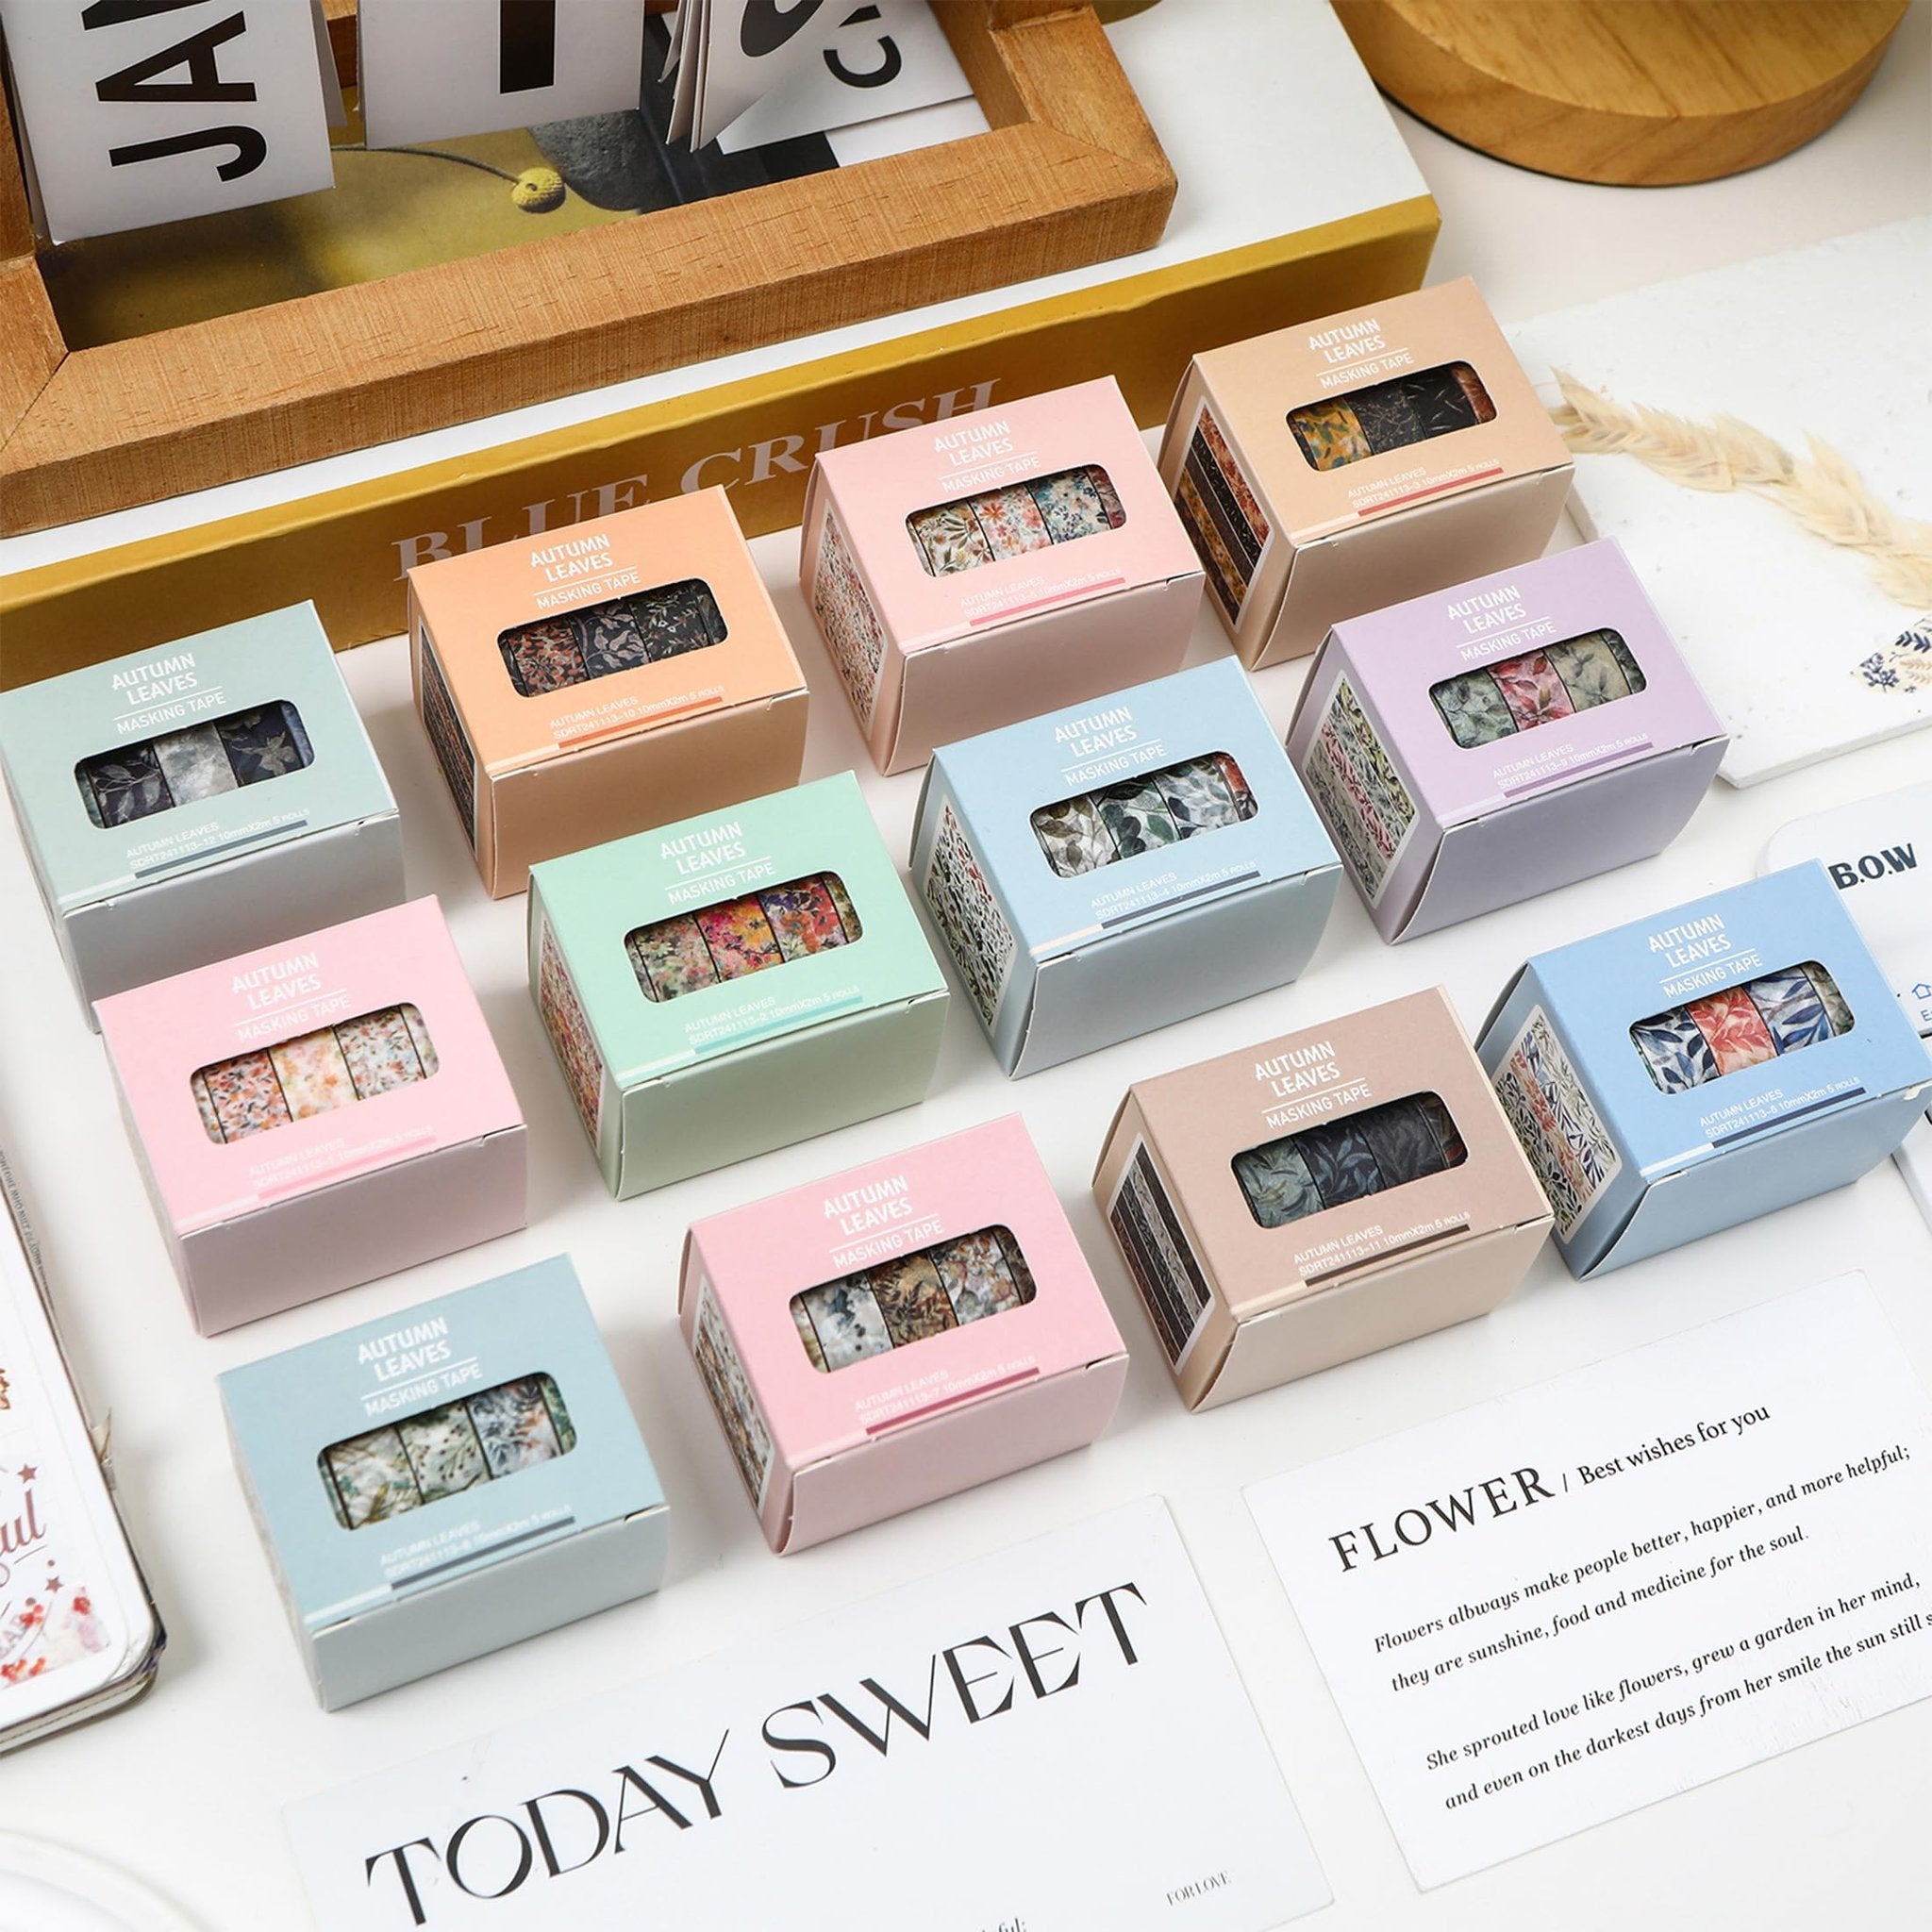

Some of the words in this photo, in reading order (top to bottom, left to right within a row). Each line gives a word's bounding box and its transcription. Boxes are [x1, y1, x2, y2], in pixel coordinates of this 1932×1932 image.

[1308, 318, 1381, 350] AUTUMN
[1324, 335, 1386, 363] LEAVES
[1320, 361, 1379, 389] MASKING
[1383, 353, 1414, 370] TAPE
[934, 420, 1011, 452] AUTUMN
[949, 438, 1013, 466] LEAVES
[941, 468, 1005, 493] MASKING
[1007, 458, 1041, 475] TAPE
[530, 534, 610, 568] AUTUMN
[545, 552, 614, 582] LEAVES
[536, 582, 603, 609] MASKING
[604, 572, 641, 591] TAPE
[1447, 586, 1521, 620] AUTUMN
[1463, 603, 1526, 634] LEAVES
[1460, 633, 1522, 661] MASKING
[1524, 622, 1557, 640] TAPE
[111, 653, 195, 691] AUTUMN
[126, 672, 198, 706] LEAVES
[116, 704, 185, 735] MASKING
[189, 691, 226, 712] TAPE
[1054, 707, 1132, 742] AUTUMN
[1070, 725, 1137, 758] LEAVES
[1064, 758, 1129, 786] MASKING
[1132, 744, 1167, 764] TAPE
[659, 822, 742, 859] AUTUMN
[675, 841, 746, 874] LEAVES
[668, 874, 736, 905] MASKING
[738, 862, 775, 882] TAPE
[1648, 913, 1725, 953] AUTUMN
[1665, 934, 1732, 968] LEAVES
[231, 951, 319, 994] AUTUMN
[247, 974, 321, 1010] LEAVES
[1662, 970, 1726, 999] MASKING
[1728, 954, 1763, 975] TAPE
[238, 1009, 308, 1041] MASKING
[310, 995, 351, 1018] TAPE
[1254, 1041, 1335, 1081] AUTUMN
[1271, 1061, 1341, 1098] LEAVES
[1265, 1097, 1332, 1129] MASKING
[1333, 1085, 1372, 1107] TAPE
[1698, 1104, 1743, 1126] AUTUMN
[1741, 1088, 1783, 1110] LEAVES
[824, 1175, 908, 1218] AUTUMN
[840, 1197, 913, 1236] LEAVES
[832, 1234, 903, 1269] MASKING
[904, 1220, 944, 1243] TAPE
[1292, 1240, 1341, 1264] AUTUMN
[1340, 1224, 1383, 1246] LEAVES
[358, 1317, 448, 1365] AUTUMN
[374, 1340, 452, 1382] LEAVES
[364, 1379, 439, 1417] MASKING
[440, 1362, 483, 1388] TAPE
[1328, 1466, 1557, 1573] FLOWER
[1576, 1457, 1625, 1486] Best
[1624, 1433, 1697, 1468] wishes
[1695, 1420, 1729, 1443] for
[1730, 1407, 1771, 1437] you
[1374, 1619, 1444, 1653] Flowers
[1448, 1591, 1520, 1626] albways
[1524, 1573, 1569, 1598] make
[1574, 1549, 1627, 1584] people
[1631, 1531, 1689, 1557] better,
[1690, 1504, 1762, 1536] happier,
[1765, 1484, 1798, 1508] and
[1801, 1472, 1843, 1495] more
[1845, 1444, 1910, 1478] helpful;
[1391, 1669, 1429, 1691] they
[1434, 1657, 1462, 1675] are
[1468, 1627, 1549, 1663] sunshine,
[1553, 1604, 1591, 1635] food
[1594, 1591, 1627, 1616] and
[1631, 1566, 1705, 1603] medicine
[1709, 1555, 1734, 1578] for
[1739, 1544, 1766, 1562] the
[1769, 1525, 1809, 1552] soul.
[1426, 1750, 1457, 1770] She
[1462, 1713, 1540, 1757] sprouted
[1542, 1704, 1578, 1725] love
[1582, 1690, 1614, 1710] like
[1619, 1665, 1689, 1703] flowers,
[1691, 1644, 1735, 1674] grew
[1739, 1639, 1751, 1652] a
[1755, 1615, 1815, 1650] garden
[1817, 1607, 1836, 1622] in
[1838, 1594, 1866, 1614] her
[1871, 1572, 1920, 1602] mind,
[1445, 1783, 1479, 1809] and
[1483, 1771, 1524, 1795] even
[1528, 1761, 1550, 1777] on
[1554, 1749, 1580, 1768] the
[1586, 1720, 1650, 1756] darkest
[1655, 1705, 1696, 1729] days
[1699, 1688, 1741, 1718] from
[1743, 1675, 1773, 1695] her
[1777, 1655, 1823, 1683] smile
[1825, 1645, 1853, 1664] the
[1856, 1633, 1887, 1653] sun
[1890, 1613, 1923, 1640] still
[364, 1728, 730, 1927] TODAY
[761, 1581, 1148, 1790] SWEET
